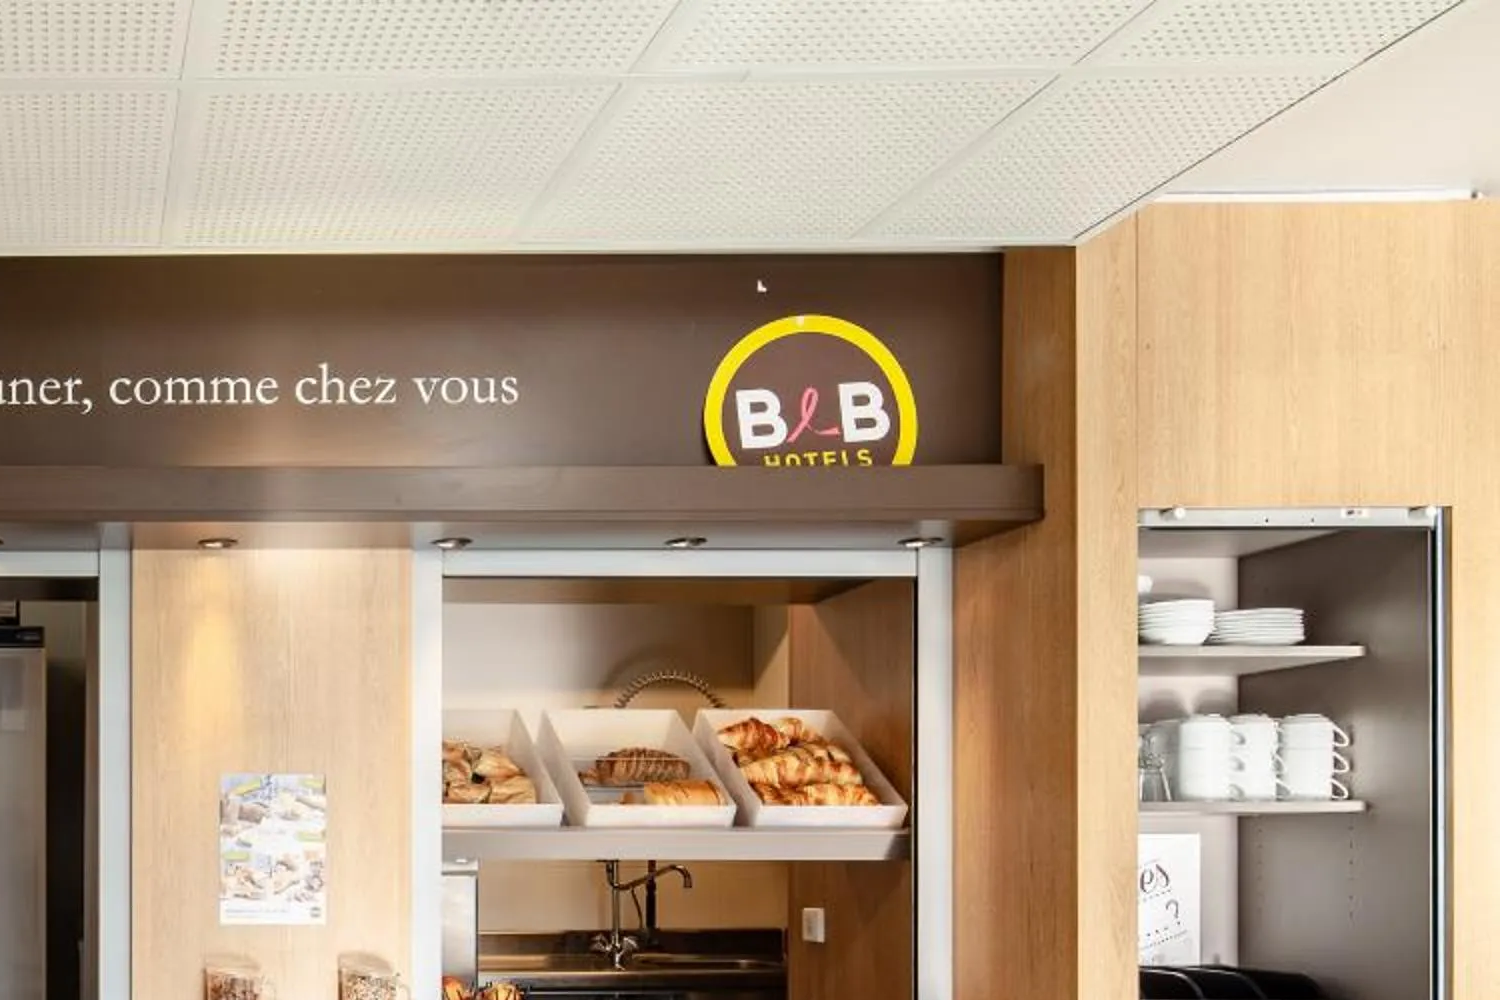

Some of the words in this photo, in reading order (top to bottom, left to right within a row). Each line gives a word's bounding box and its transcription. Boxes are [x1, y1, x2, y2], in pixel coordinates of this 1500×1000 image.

[108, 376, 279, 405] comme
[295, 363, 397, 405] chez
[412, 376, 519, 405] vous
